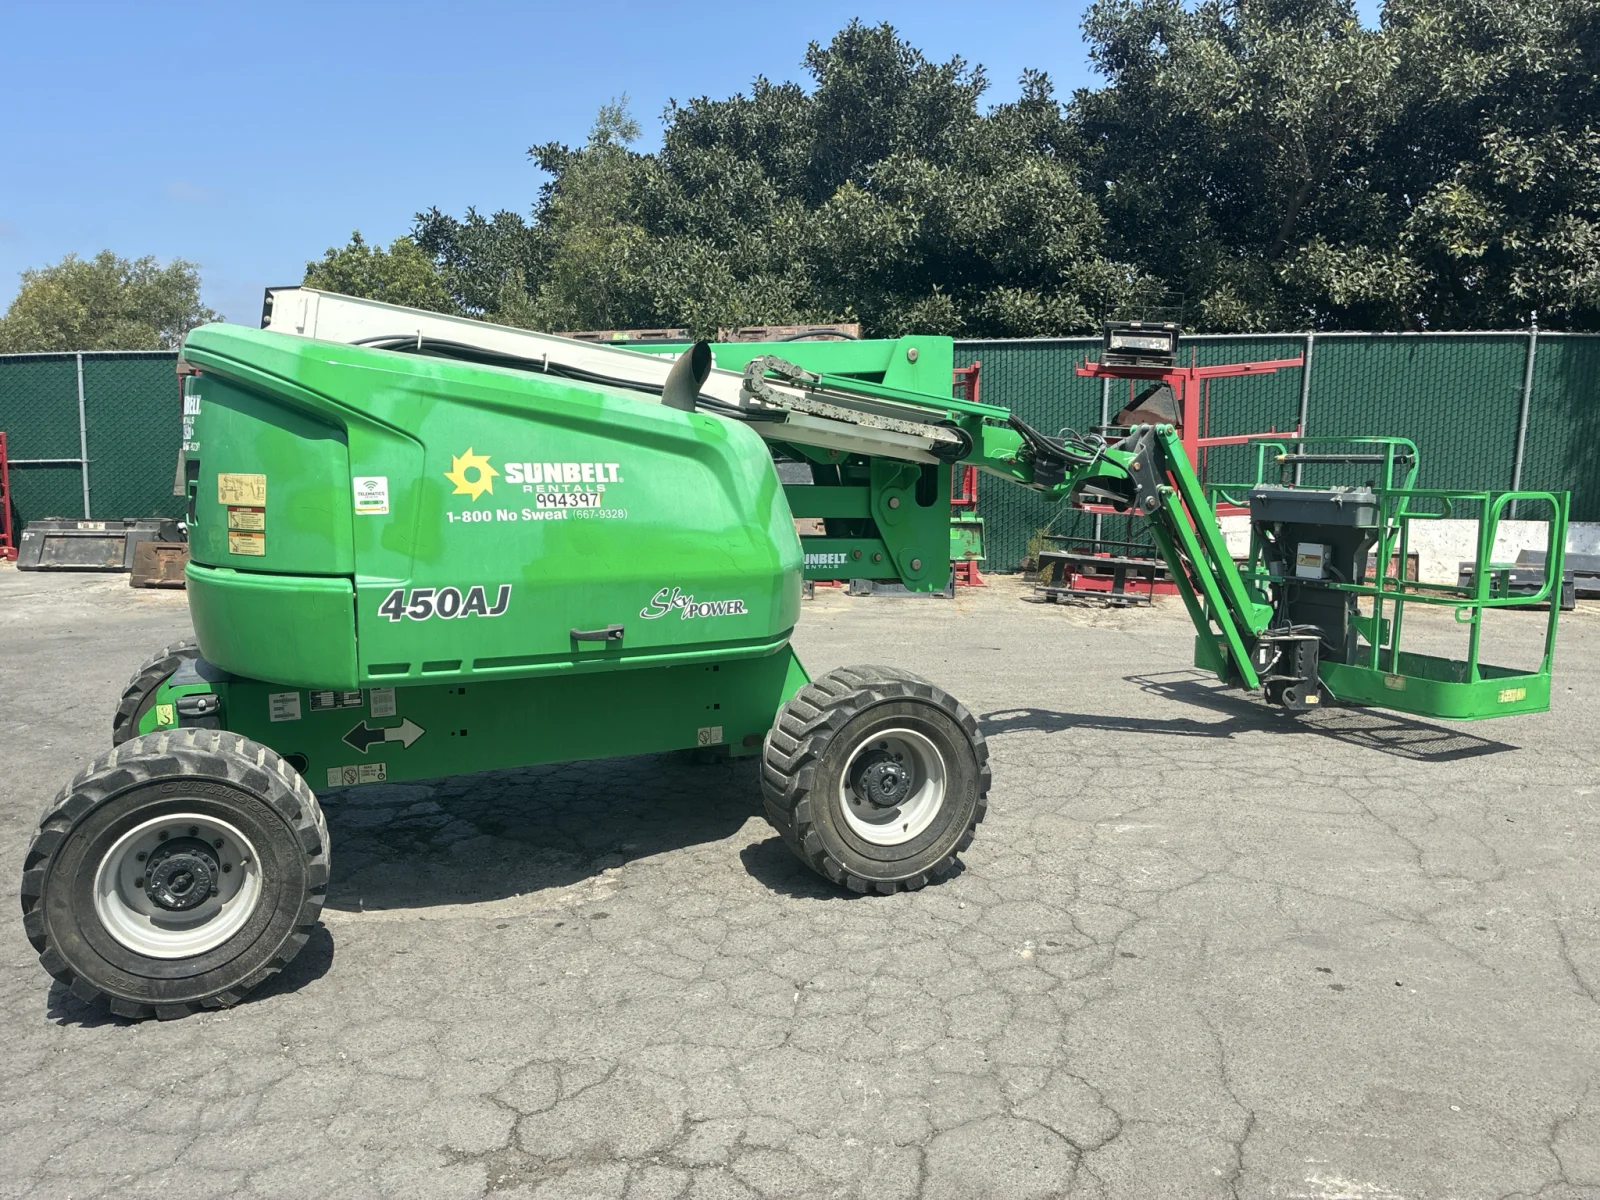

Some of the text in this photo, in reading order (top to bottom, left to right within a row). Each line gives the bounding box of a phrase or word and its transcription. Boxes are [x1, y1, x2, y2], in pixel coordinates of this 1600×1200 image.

[504, 462, 620, 484] SUNBELT
[523, 484, 606, 493] RENTALS
[536, 493, 598, 507] 994397
[446, 508, 628, 523] 1-800 No Sweat (667-9328)
[804, 553, 847, 564] UNBELT
[377, 584, 512, 622] 450AJ
